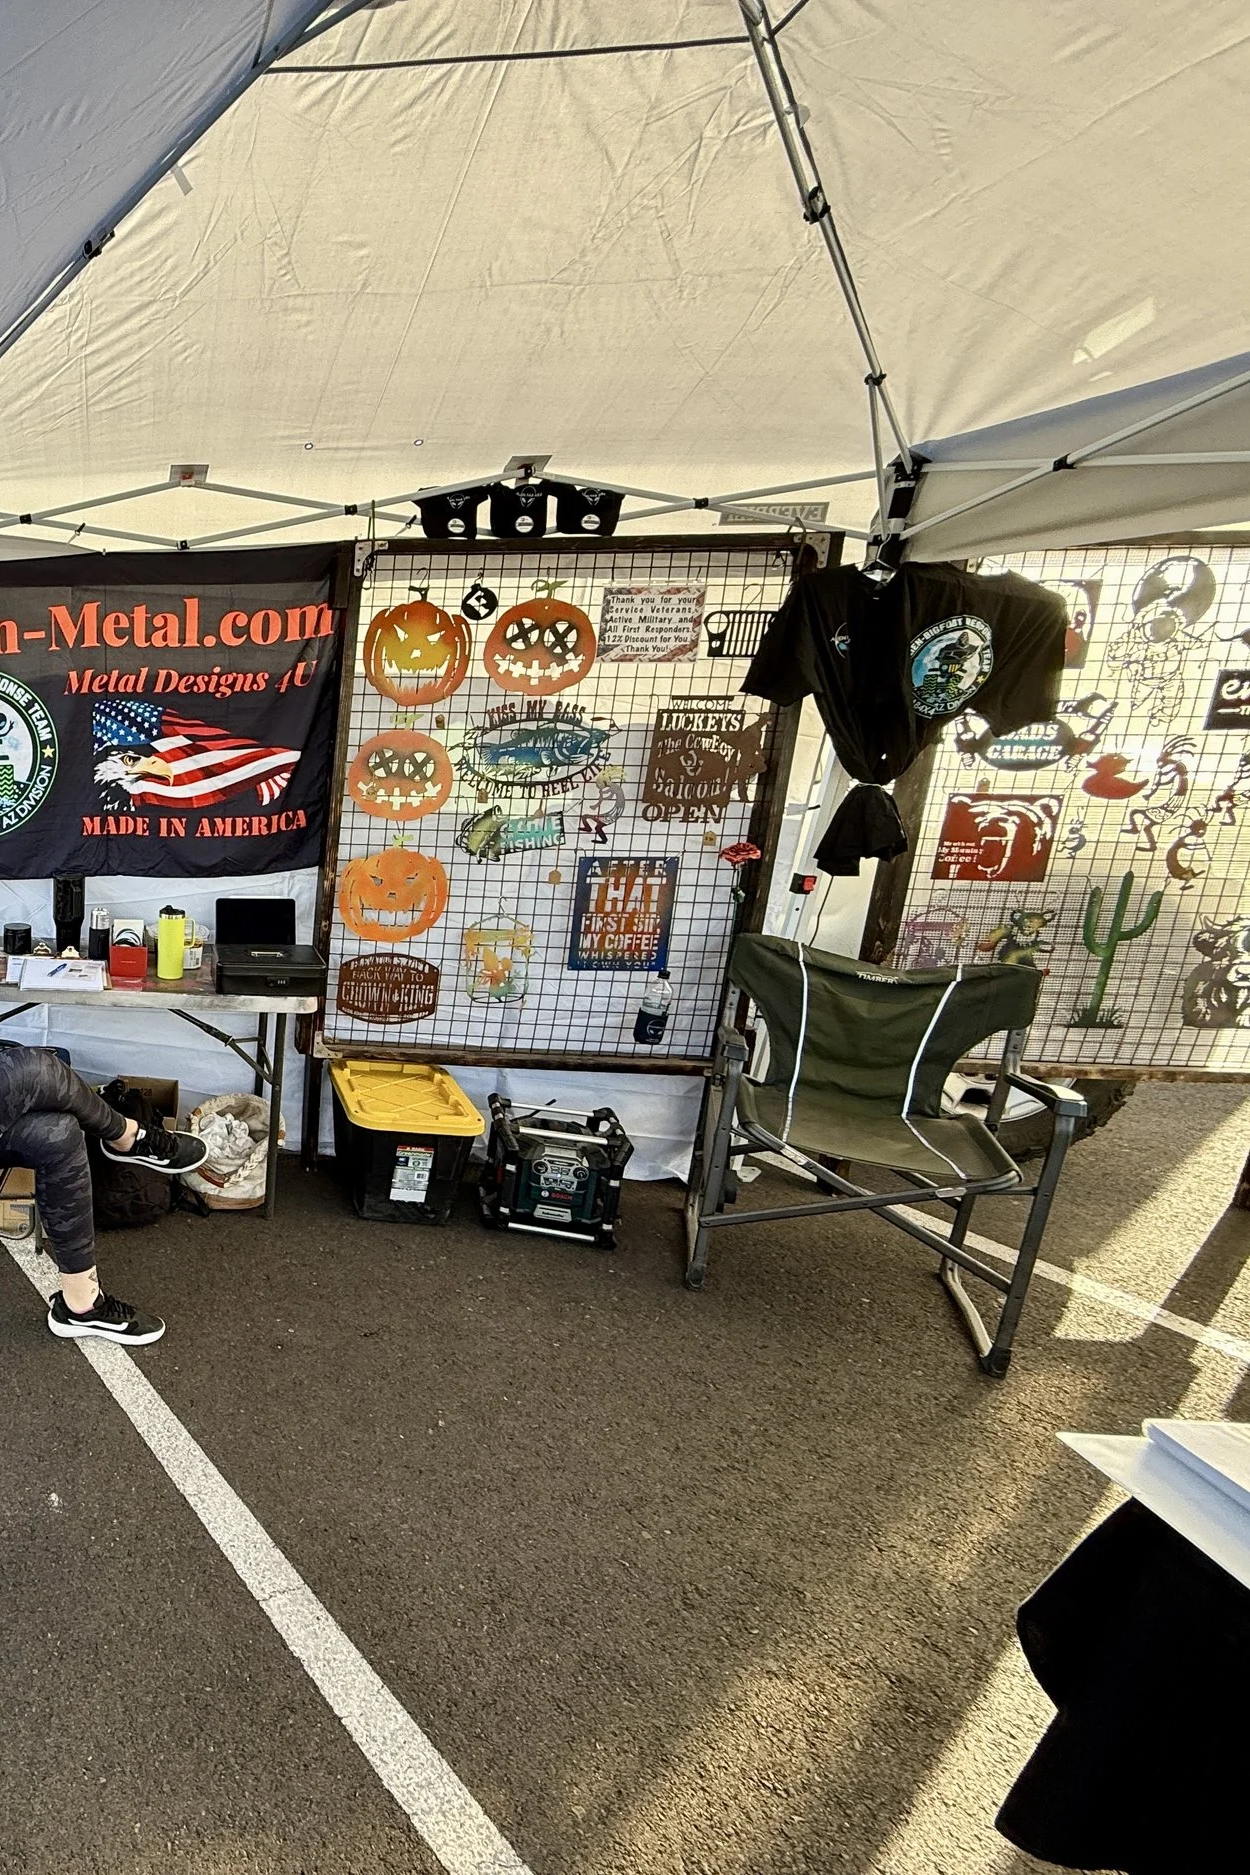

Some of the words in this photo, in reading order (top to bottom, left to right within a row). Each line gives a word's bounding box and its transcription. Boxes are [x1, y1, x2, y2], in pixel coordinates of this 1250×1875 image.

[609, 606, 644, 614] Service
[611, 596, 635, 604] Thank
[641, 597, 655, 605] you
[661, 596, 672, 604] for
[678, 597, 696, 605] your
[607, 625, 618, 633] All
[622, 625, 640, 633] First
[638, 616, 673, 624] Military
[625, 635, 657, 643] Discount
[660, 635, 671, 643] for
[626, 645, 649, 653] Thank
[652, 645, 668, 653] You!
[64, 667, 151, 696] Metal
[154, 665, 269, 699] Designs
[274, 660, 317, 694] 4U
[28, 702, 53, 741] TEAM
[487, 702, 516, 728] KISS
[526, 700, 547, 720] MY
[553, 700, 587, 726] BASS
[660, 712, 741, 732] LUCKEYS
[454, 756, 512, 799] WELCOME
[520, 785, 536, 799] TO
[542, 777, 579, 798] REEL
[2, 811, 19, 829] AZ
[17, 765, 53, 817] DIVISION
[642, 802, 722, 824] OPEN
[82, 816, 150, 837] MADE
[159, 816, 186, 837] IN
[195, 811, 308, 837] AMERICA
[500, 833, 565, 855] FISHING
[587, 860, 667, 876] AFTER
[586, 877, 667, 912] THAT
[581, 913, 629, 932] FIRST
[579, 933, 601, 950] MY
[604, 933, 660, 950] COFFEE
[399, 984, 434, 1012] KING
